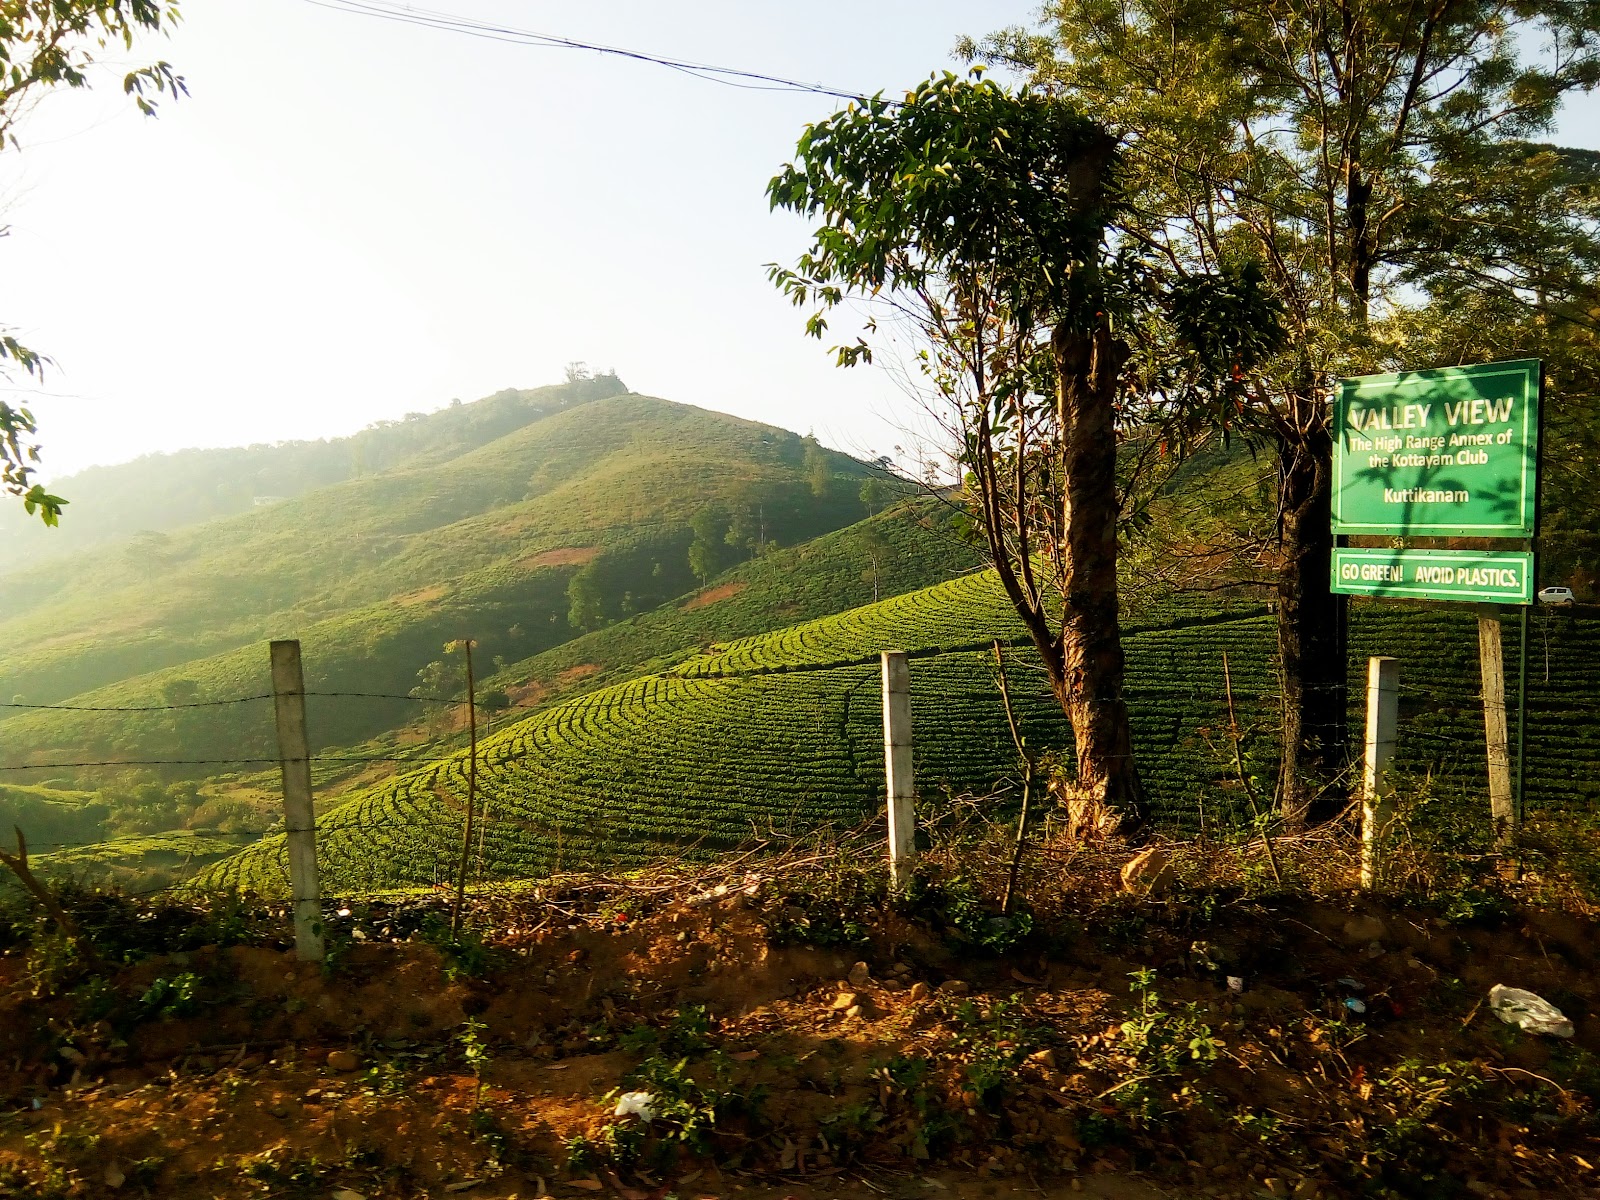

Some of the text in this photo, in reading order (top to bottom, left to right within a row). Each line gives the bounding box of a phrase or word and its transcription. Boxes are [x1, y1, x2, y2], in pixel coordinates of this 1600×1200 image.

[1350, 397, 1514, 431] VALLEY VIEW
[1350, 429, 1513, 453] The High Range Annex of
[1369, 450, 1488, 469] the Kottayam Club
[1384, 488, 1469, 503] Kuttikanam
[1342, 564, 1520, 588] GO GREEN! AVOID PLASTICS.
